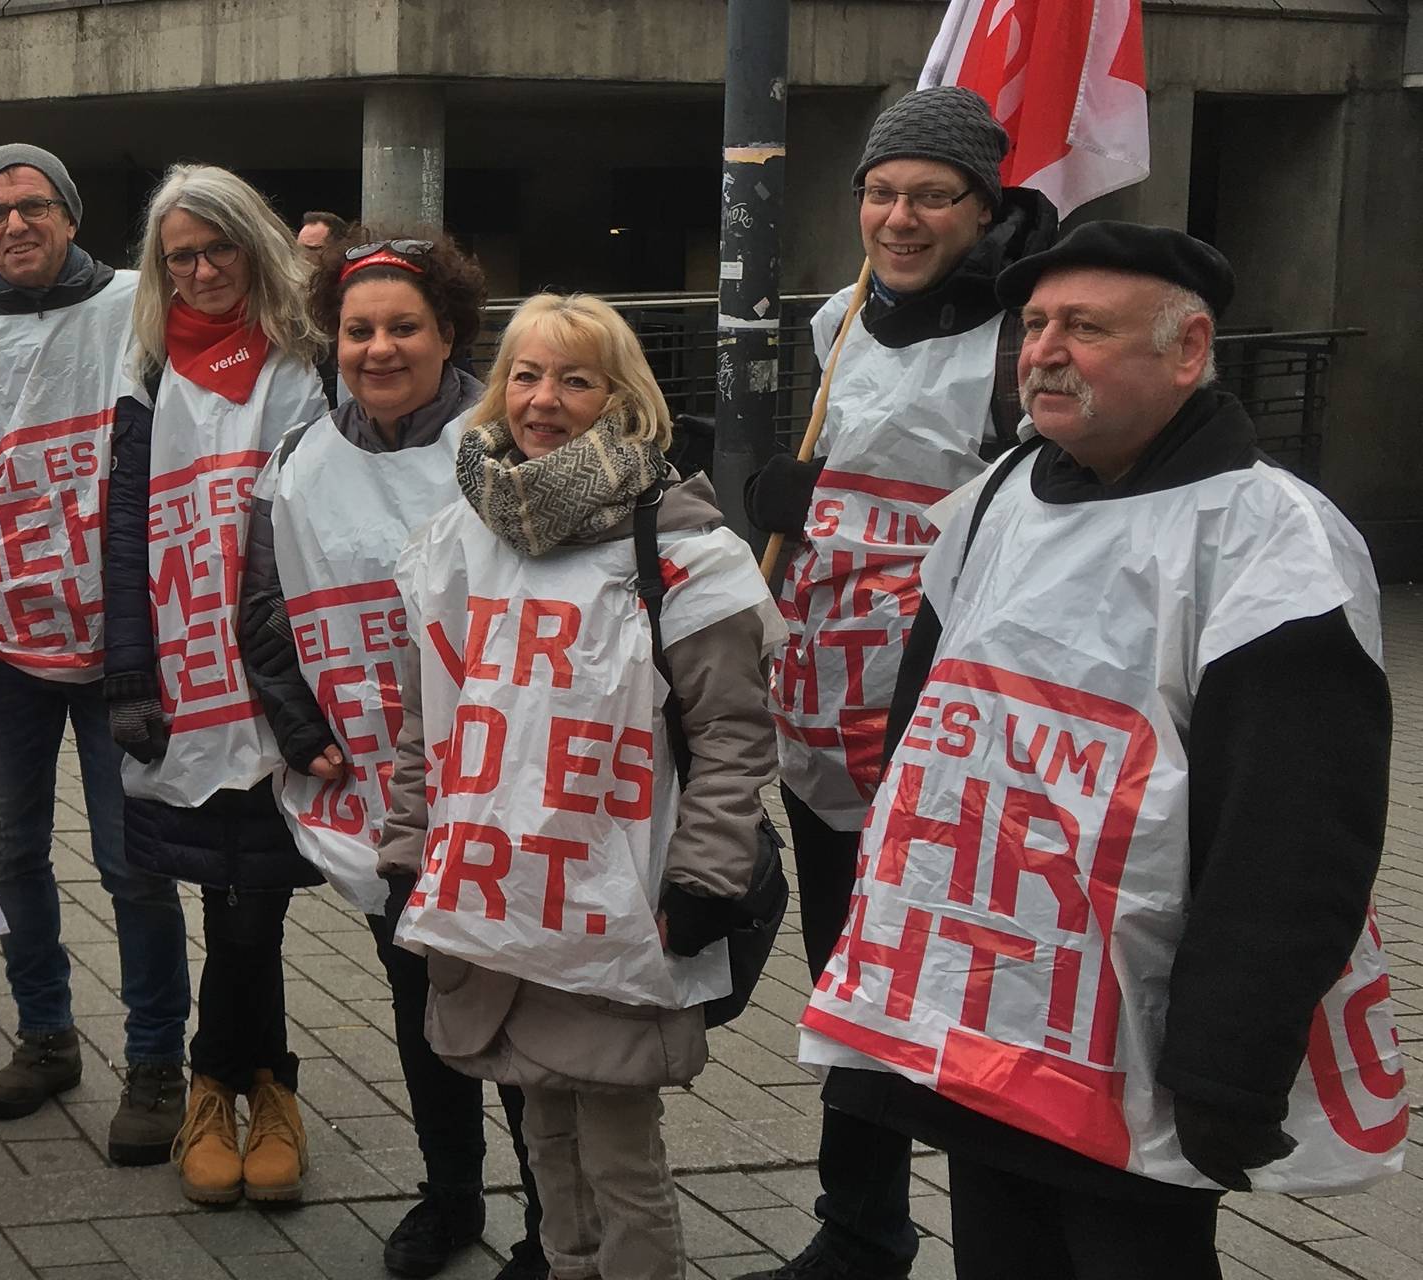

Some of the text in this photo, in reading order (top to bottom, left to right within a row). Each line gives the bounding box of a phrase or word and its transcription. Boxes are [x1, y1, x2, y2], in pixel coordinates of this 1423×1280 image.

[209, 346, 250, 373] ver.di
[44, 441, 98, 484] ES
[209, 477, 255, 516] ES
[863, 506, 939, 546] UM
[360, 607, 409, 653] ES
[542, 716, 654, 821] ES
[903, 695, 1107, 798] ES UM
[856, 760, 1090, 934] HR
